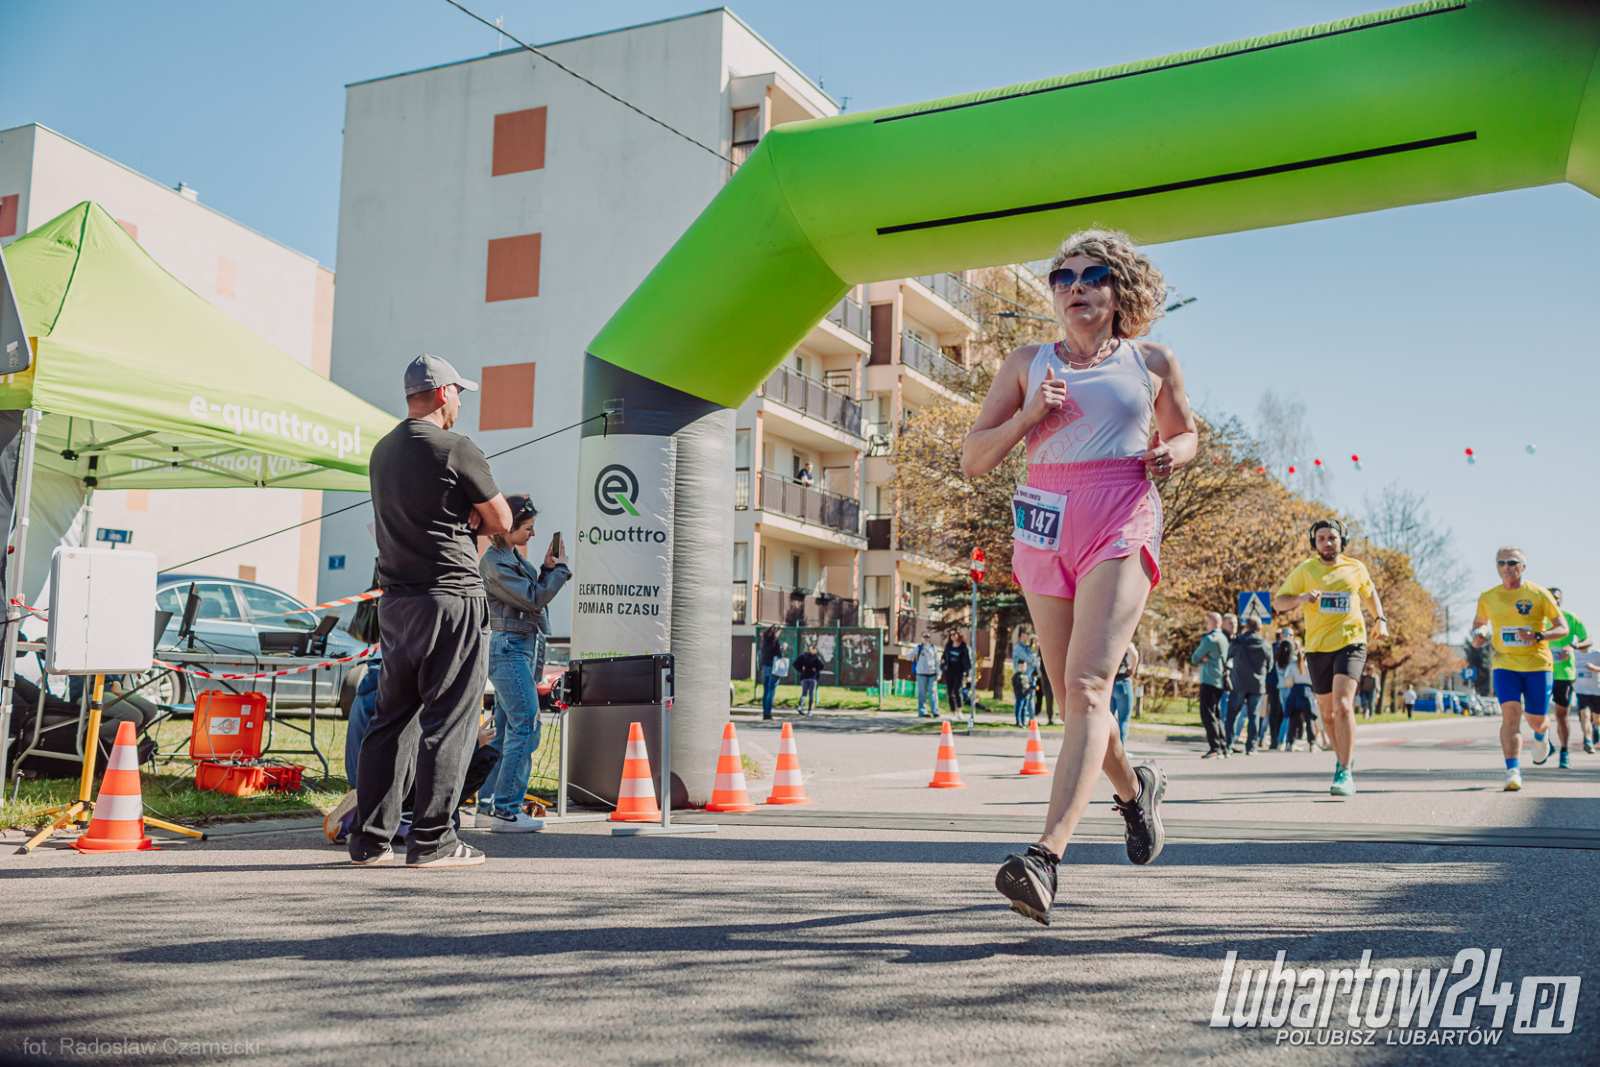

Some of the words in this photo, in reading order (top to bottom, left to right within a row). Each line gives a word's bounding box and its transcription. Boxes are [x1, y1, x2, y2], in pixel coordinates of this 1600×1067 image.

[189, 395, 361, 458] e-quattro.pl
[1030, 508, 1056, 534] 147
[579, 583, 660, 597] ELEKTRONICZNY
[578, 602, 613, 614] POMIAR
[617, 603, 659, 616] CZASU
